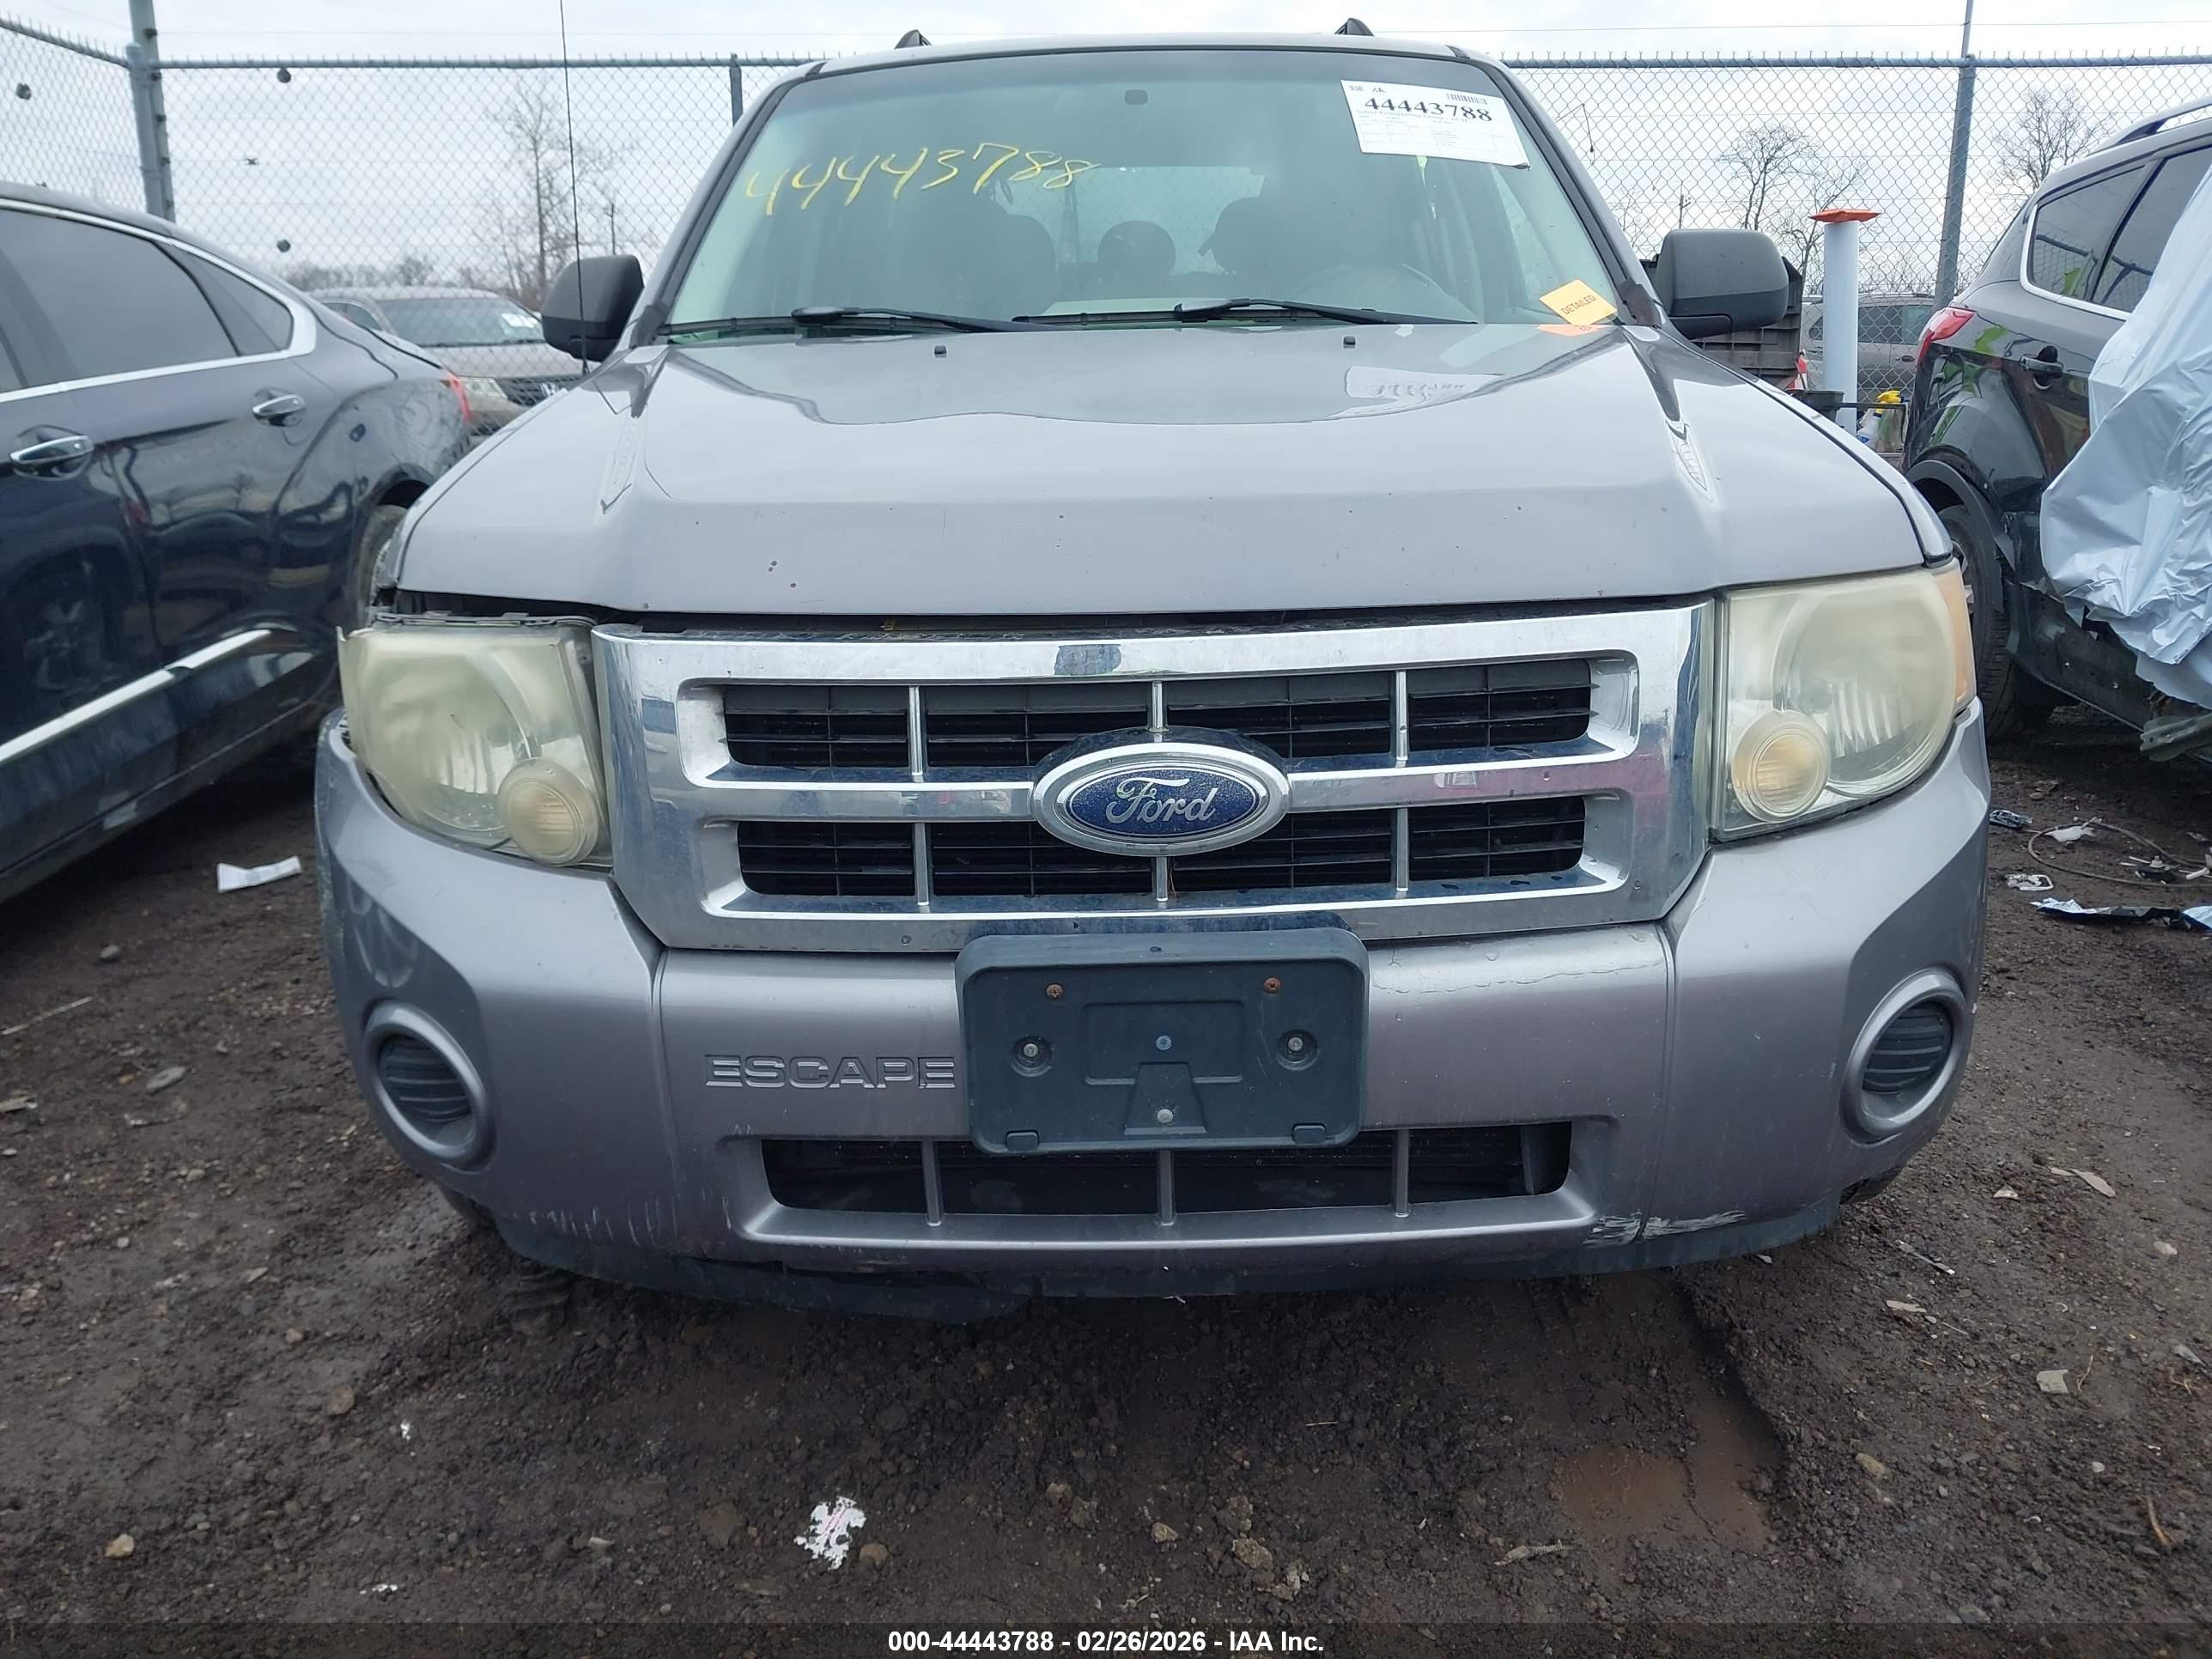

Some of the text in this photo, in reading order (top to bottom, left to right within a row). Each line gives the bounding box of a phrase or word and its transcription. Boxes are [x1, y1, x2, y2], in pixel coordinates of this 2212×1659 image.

[1364, 97, 1492, 122] 44443788
[744, 143, 1101, 216] 44443788
[1560, 295, 1597, 315] DETAILED
[1105, 777, 1218, 823] Ford
[704, 1054, 956, 1089] ESCAPE
